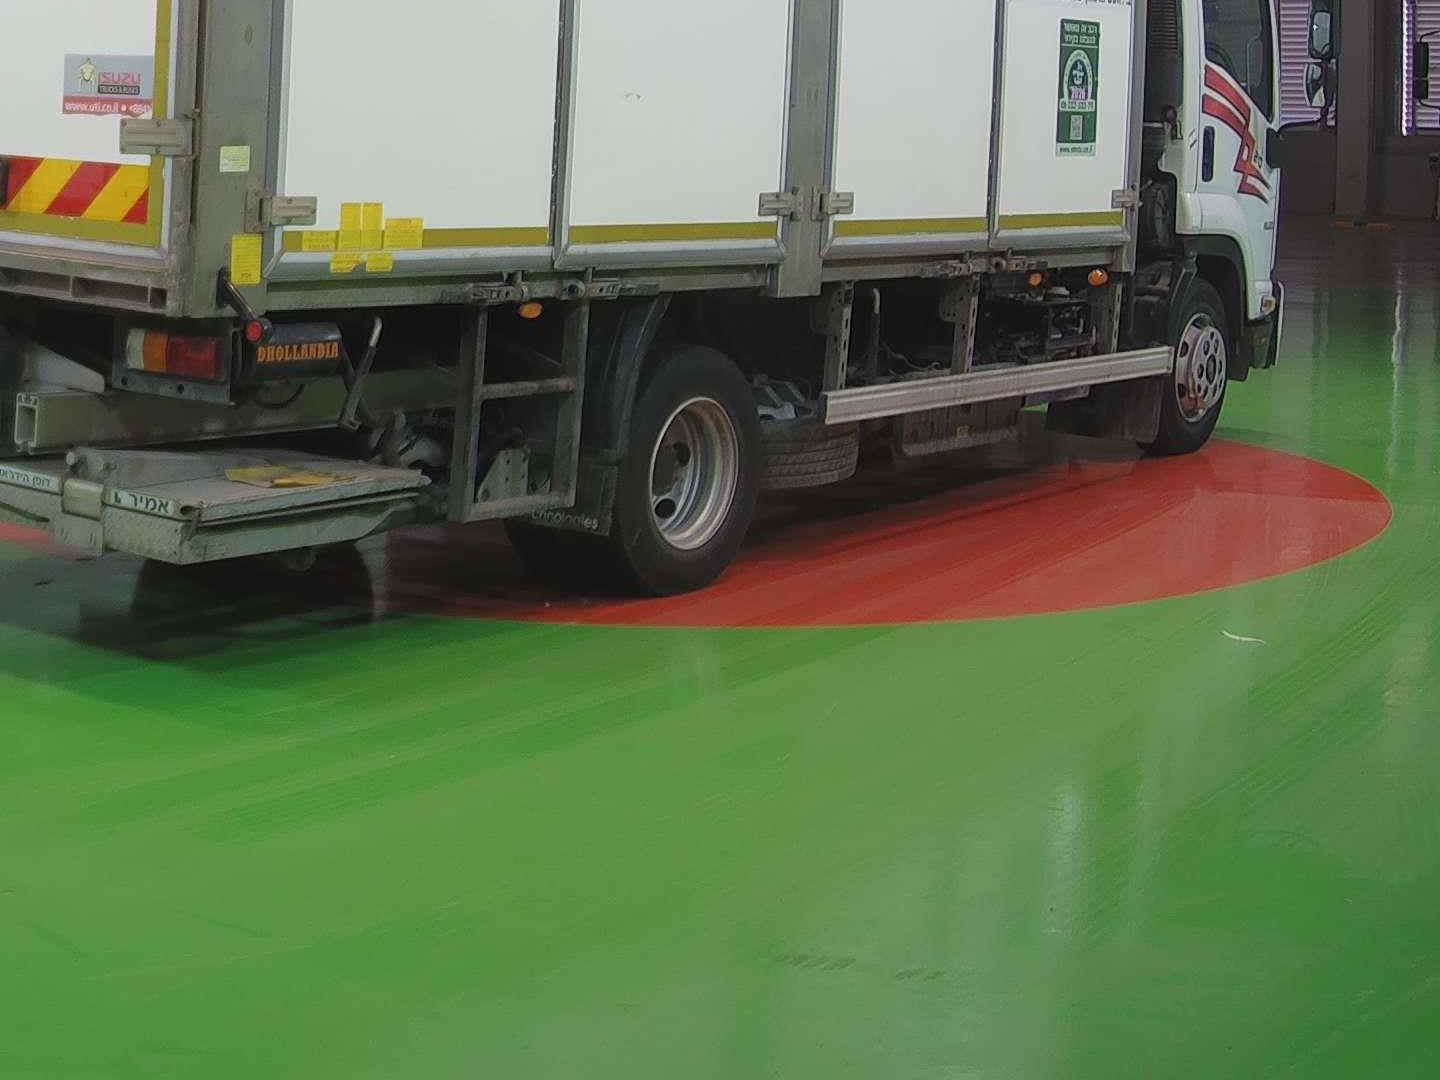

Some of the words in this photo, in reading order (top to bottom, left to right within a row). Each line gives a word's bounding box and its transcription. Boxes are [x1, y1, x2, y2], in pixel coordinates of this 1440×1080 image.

[97, 72, 141, 85] ISUZU
[257, 341, 339, 363] DHOLLANDIA
[128, 493, 169, 514] אמיר
